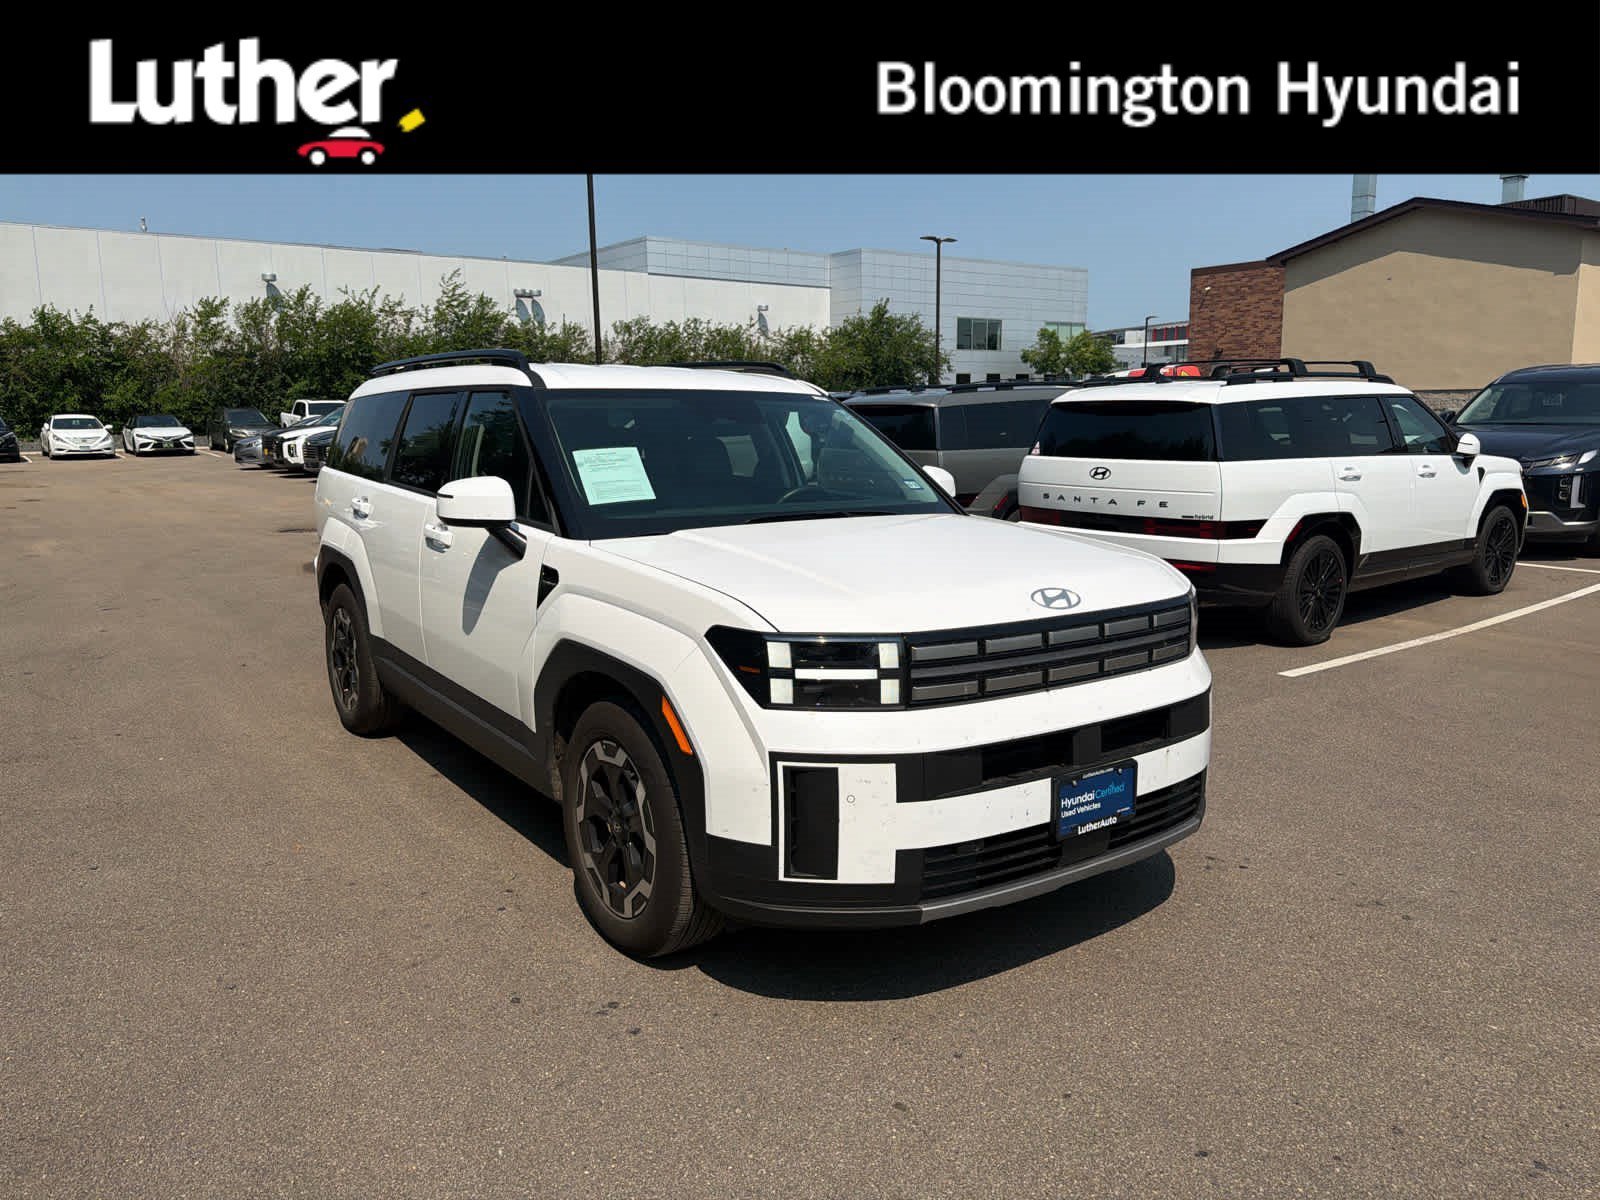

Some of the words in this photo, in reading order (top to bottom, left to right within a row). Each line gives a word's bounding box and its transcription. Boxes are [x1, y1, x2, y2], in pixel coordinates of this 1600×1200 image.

[1043, 493, 1118, 506] SANTA
[1137, 500, 1168, 508] FE
[1061, 790, 1095, 808] Hyundai
[1061, 808, 1076, 818] Used
[1077, 802, 1101, 813] Vehicles
[1078, 816, 1118, 835] LutherAuto
